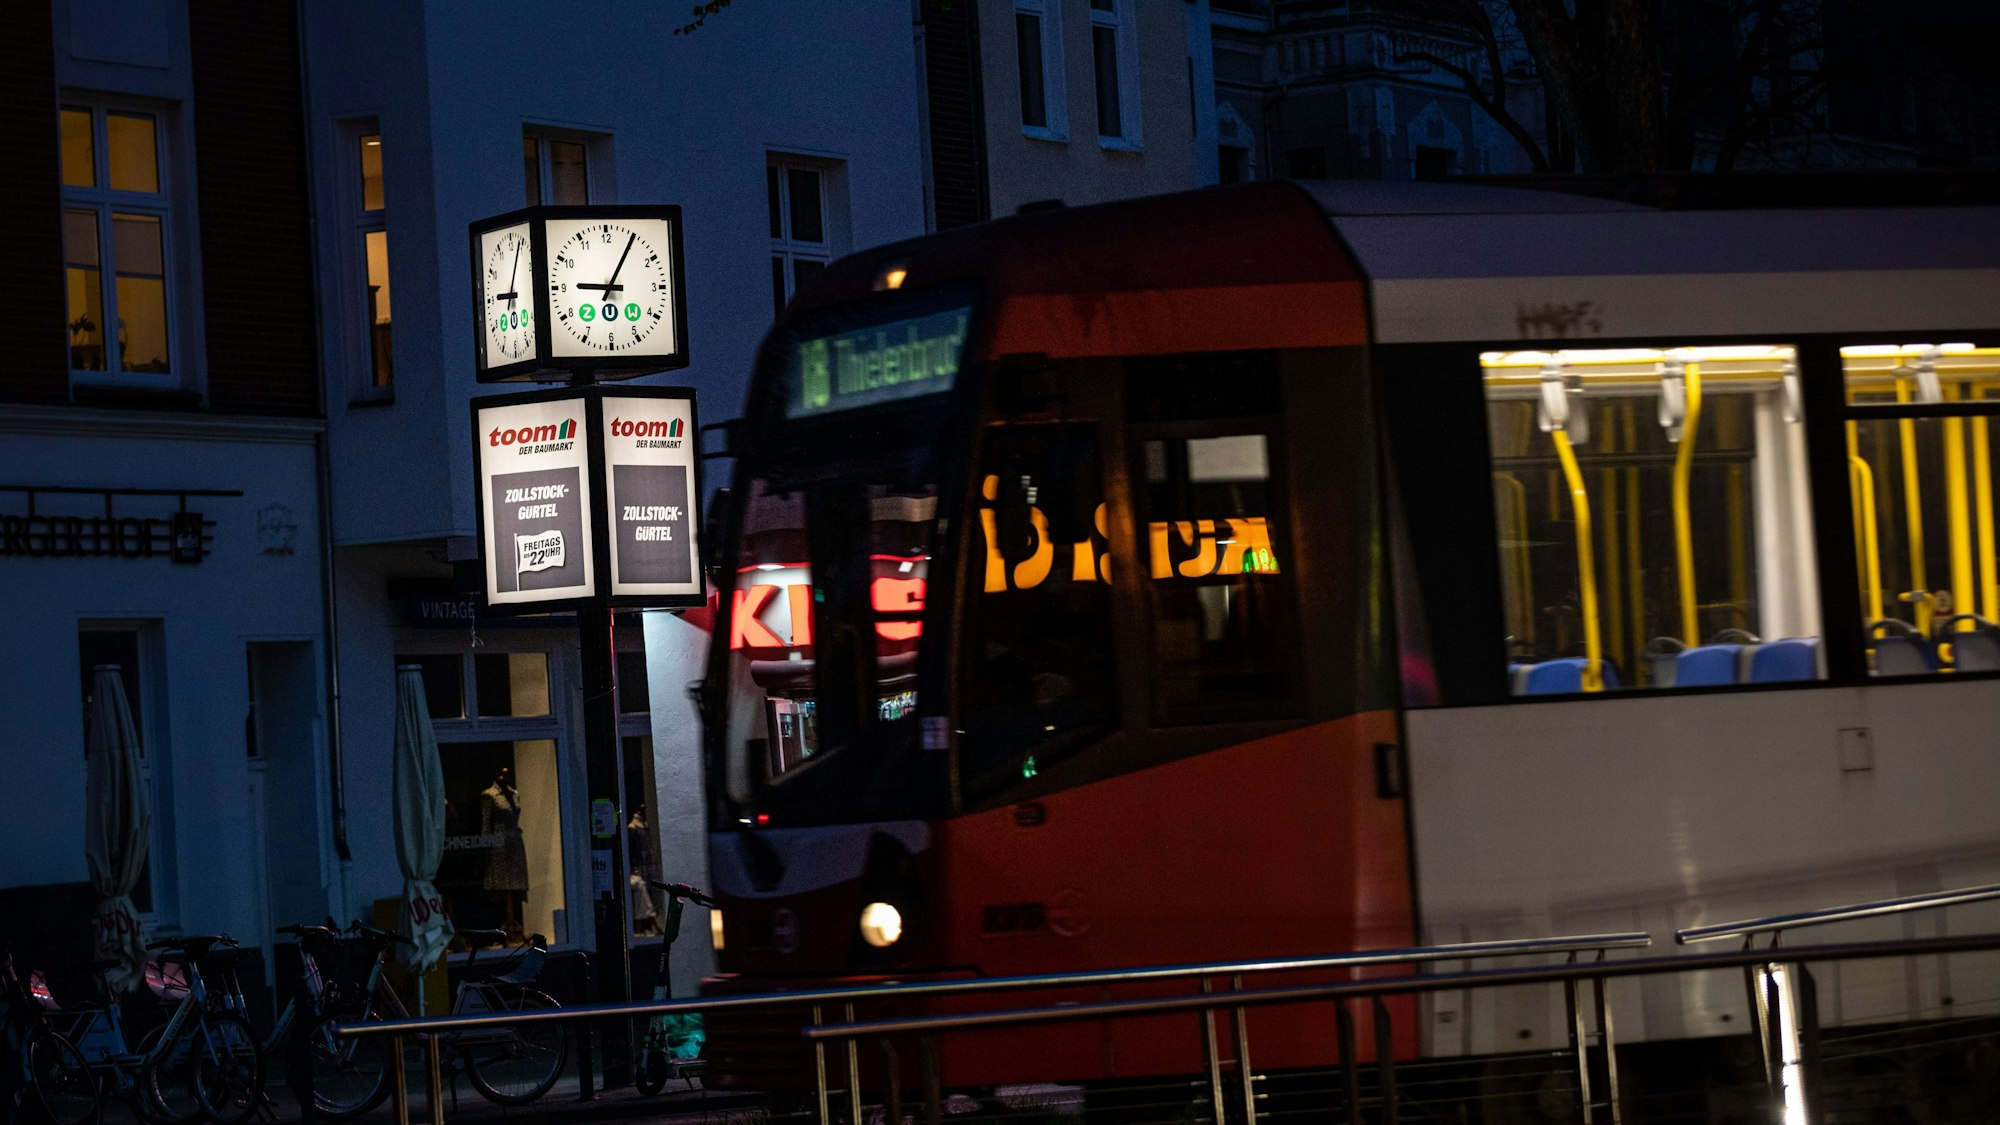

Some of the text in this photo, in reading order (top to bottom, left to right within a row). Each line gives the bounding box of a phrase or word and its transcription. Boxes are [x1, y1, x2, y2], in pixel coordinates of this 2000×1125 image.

[602, 234, 611, 243] 12
[581, 241, 589, 250] 11
[565, 259, 574, 268] 10
[644, 258, 650, 268] 2
[562, 284, 566, 292] 9
[652, 282, 657, 292] 3
[568, 308, 574, 317] 8
[582, 306, 638, 319] Z U W
[647, 307, 652, 316] 4
[586, 326, 591, 336] 7
[632, 326, 637, 335] 5
[608, 332, 614, 342] 6
[611, 416, 668, 437] toom
[489, 424, 557, 447] toom
[518, 442, 574, 456] DER BAUMARKT
[636, 440, 682, 449] DER BAUMARKT
[504, 484, 570, 503] ZOLLSTOCK-
[518, 504, 558, 520] GÜRTEL
[623, 506, 682, 521] ZOLLSTOCK-
[635, 526, 672, 541] GÜRTEL
[524, 536, 561, 552] FREITAGS
[530, 550, 545, 566] 22
[545, 546, 561, 558] UHR
[421, 601, 476, 619] VINTAGE
